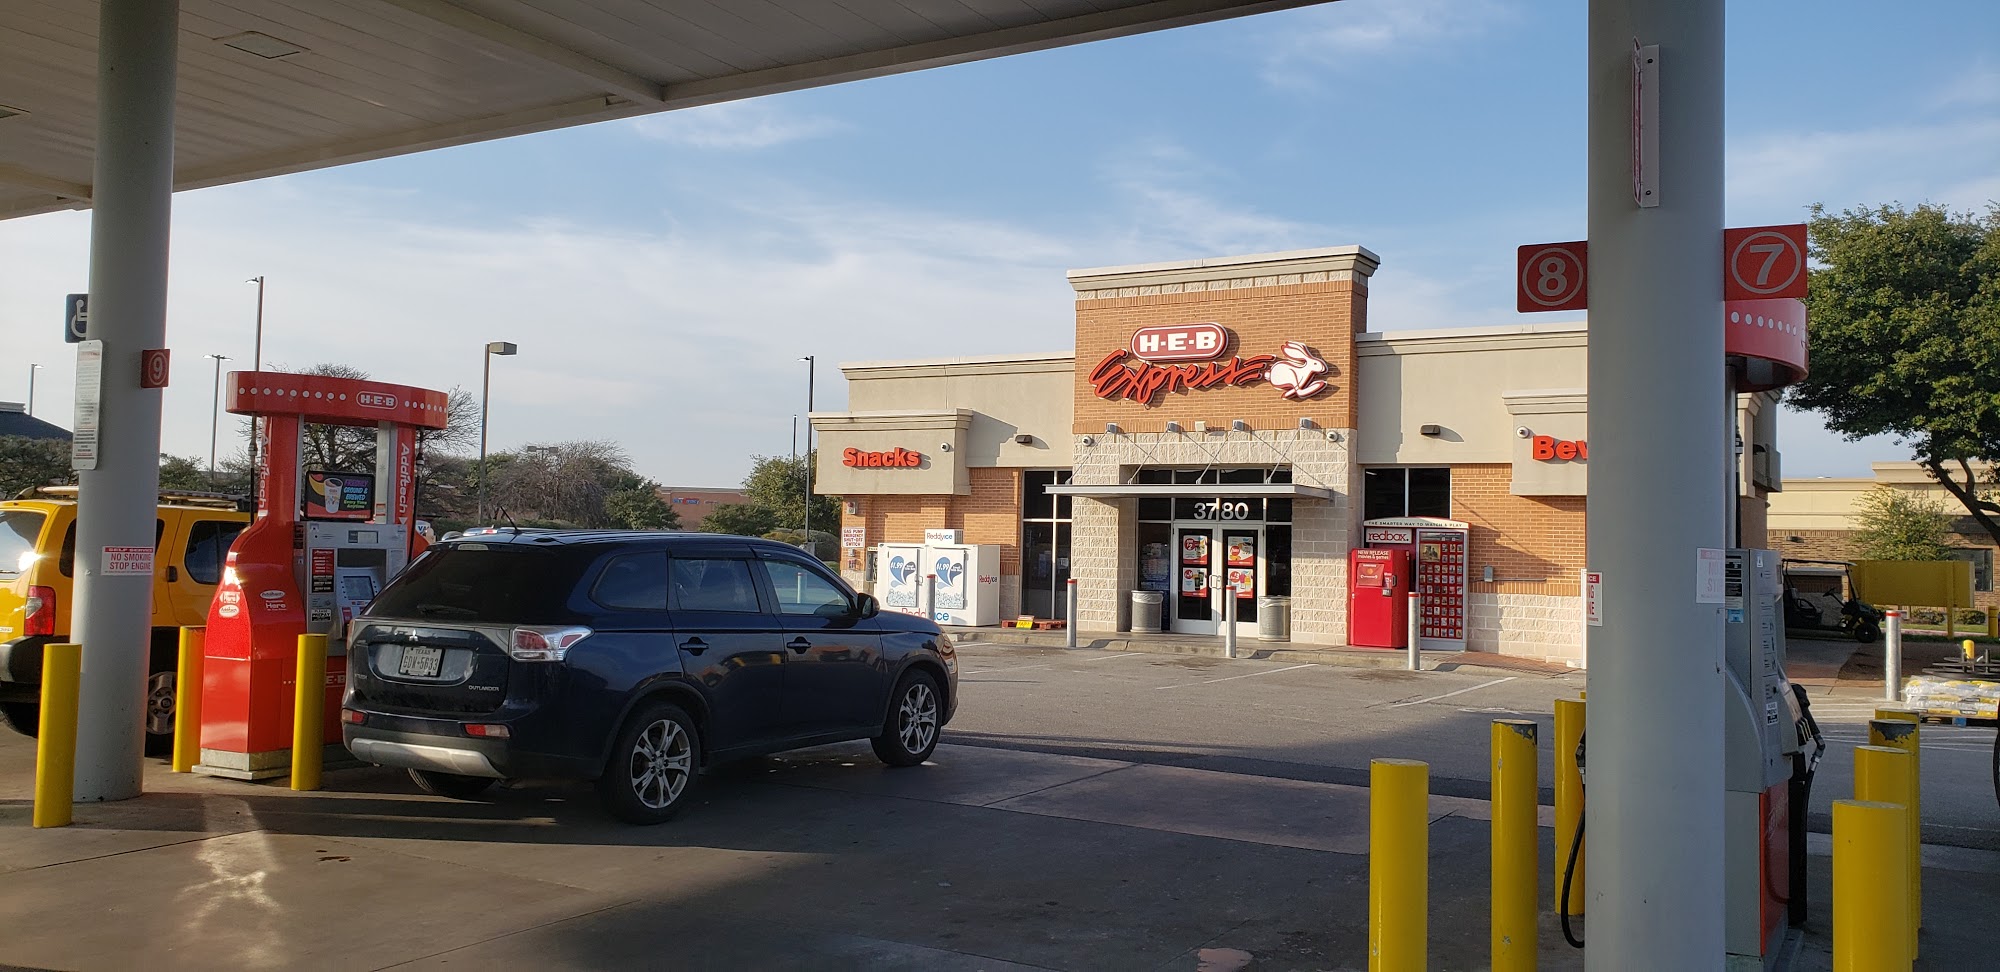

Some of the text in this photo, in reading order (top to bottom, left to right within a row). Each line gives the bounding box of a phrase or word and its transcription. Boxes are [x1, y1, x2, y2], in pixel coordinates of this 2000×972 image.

[1749, 243, 1785, 285] 7
[1537, 257, 1568, 296] 8
[153, 356, 164, 380] 9
[1089, 349, 1275, 405] Express
[842, 447, 922, 468] Snacks
[399, 442, 411, 514] Additech
[1193, 502, 1249, 520] 3780
[110, 553, 122, 561] NO
[110, 561, 130, 570] STOP
